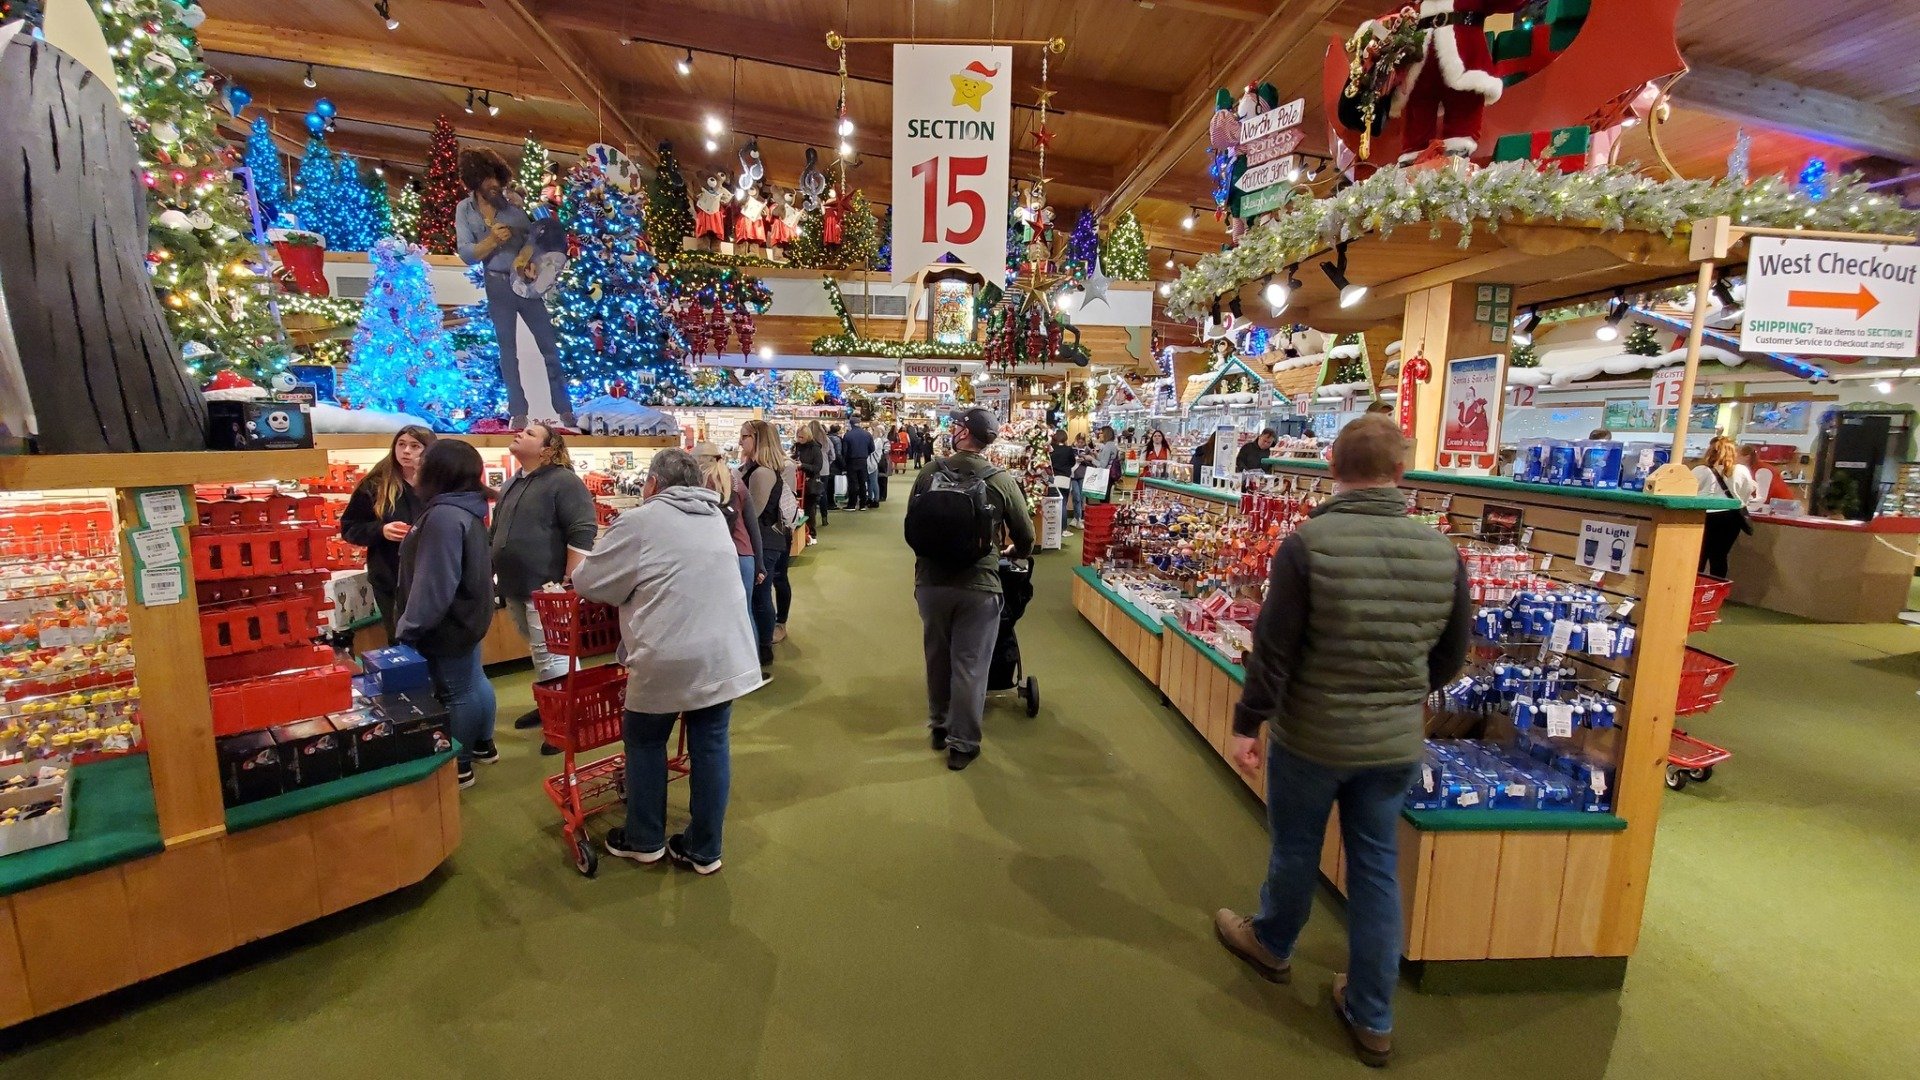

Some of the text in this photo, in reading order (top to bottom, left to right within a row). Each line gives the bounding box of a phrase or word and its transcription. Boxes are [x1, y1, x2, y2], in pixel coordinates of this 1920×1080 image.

[907, 118, 995, 141] SECTION
[1241, 104, 1299, 142] North Pole
[911, 155, 988, 245] 15
[1758, 252, 1917, 285] West Checkout
[1749, 320, 1814, 334] SHIPPING?
[1815, 326, 1833, 335] Take
[1834, 327, 1856, 336] items
[1857, 328, 1866, 336] to
[1867, 328, 1903, 338] SECTION
[1755, 336, 1793, 345] Customer
[1794, 337, 1823, 346] Service
[1823, 338, 1832, 346] to
[1833, 338, 1868, 348] checkout
[1869, 340, 1885, 349] and
[906, 365, 947, 373] CHECKOUT
[1655, 371, 1685, 379] REGISTE
[1512, 385, 1535, 407] 12
[1655, 380, 1684, 406] 13
[1297, 400, 1307, 414] 10
[1585, 524, 1630, 538] Bud Light
